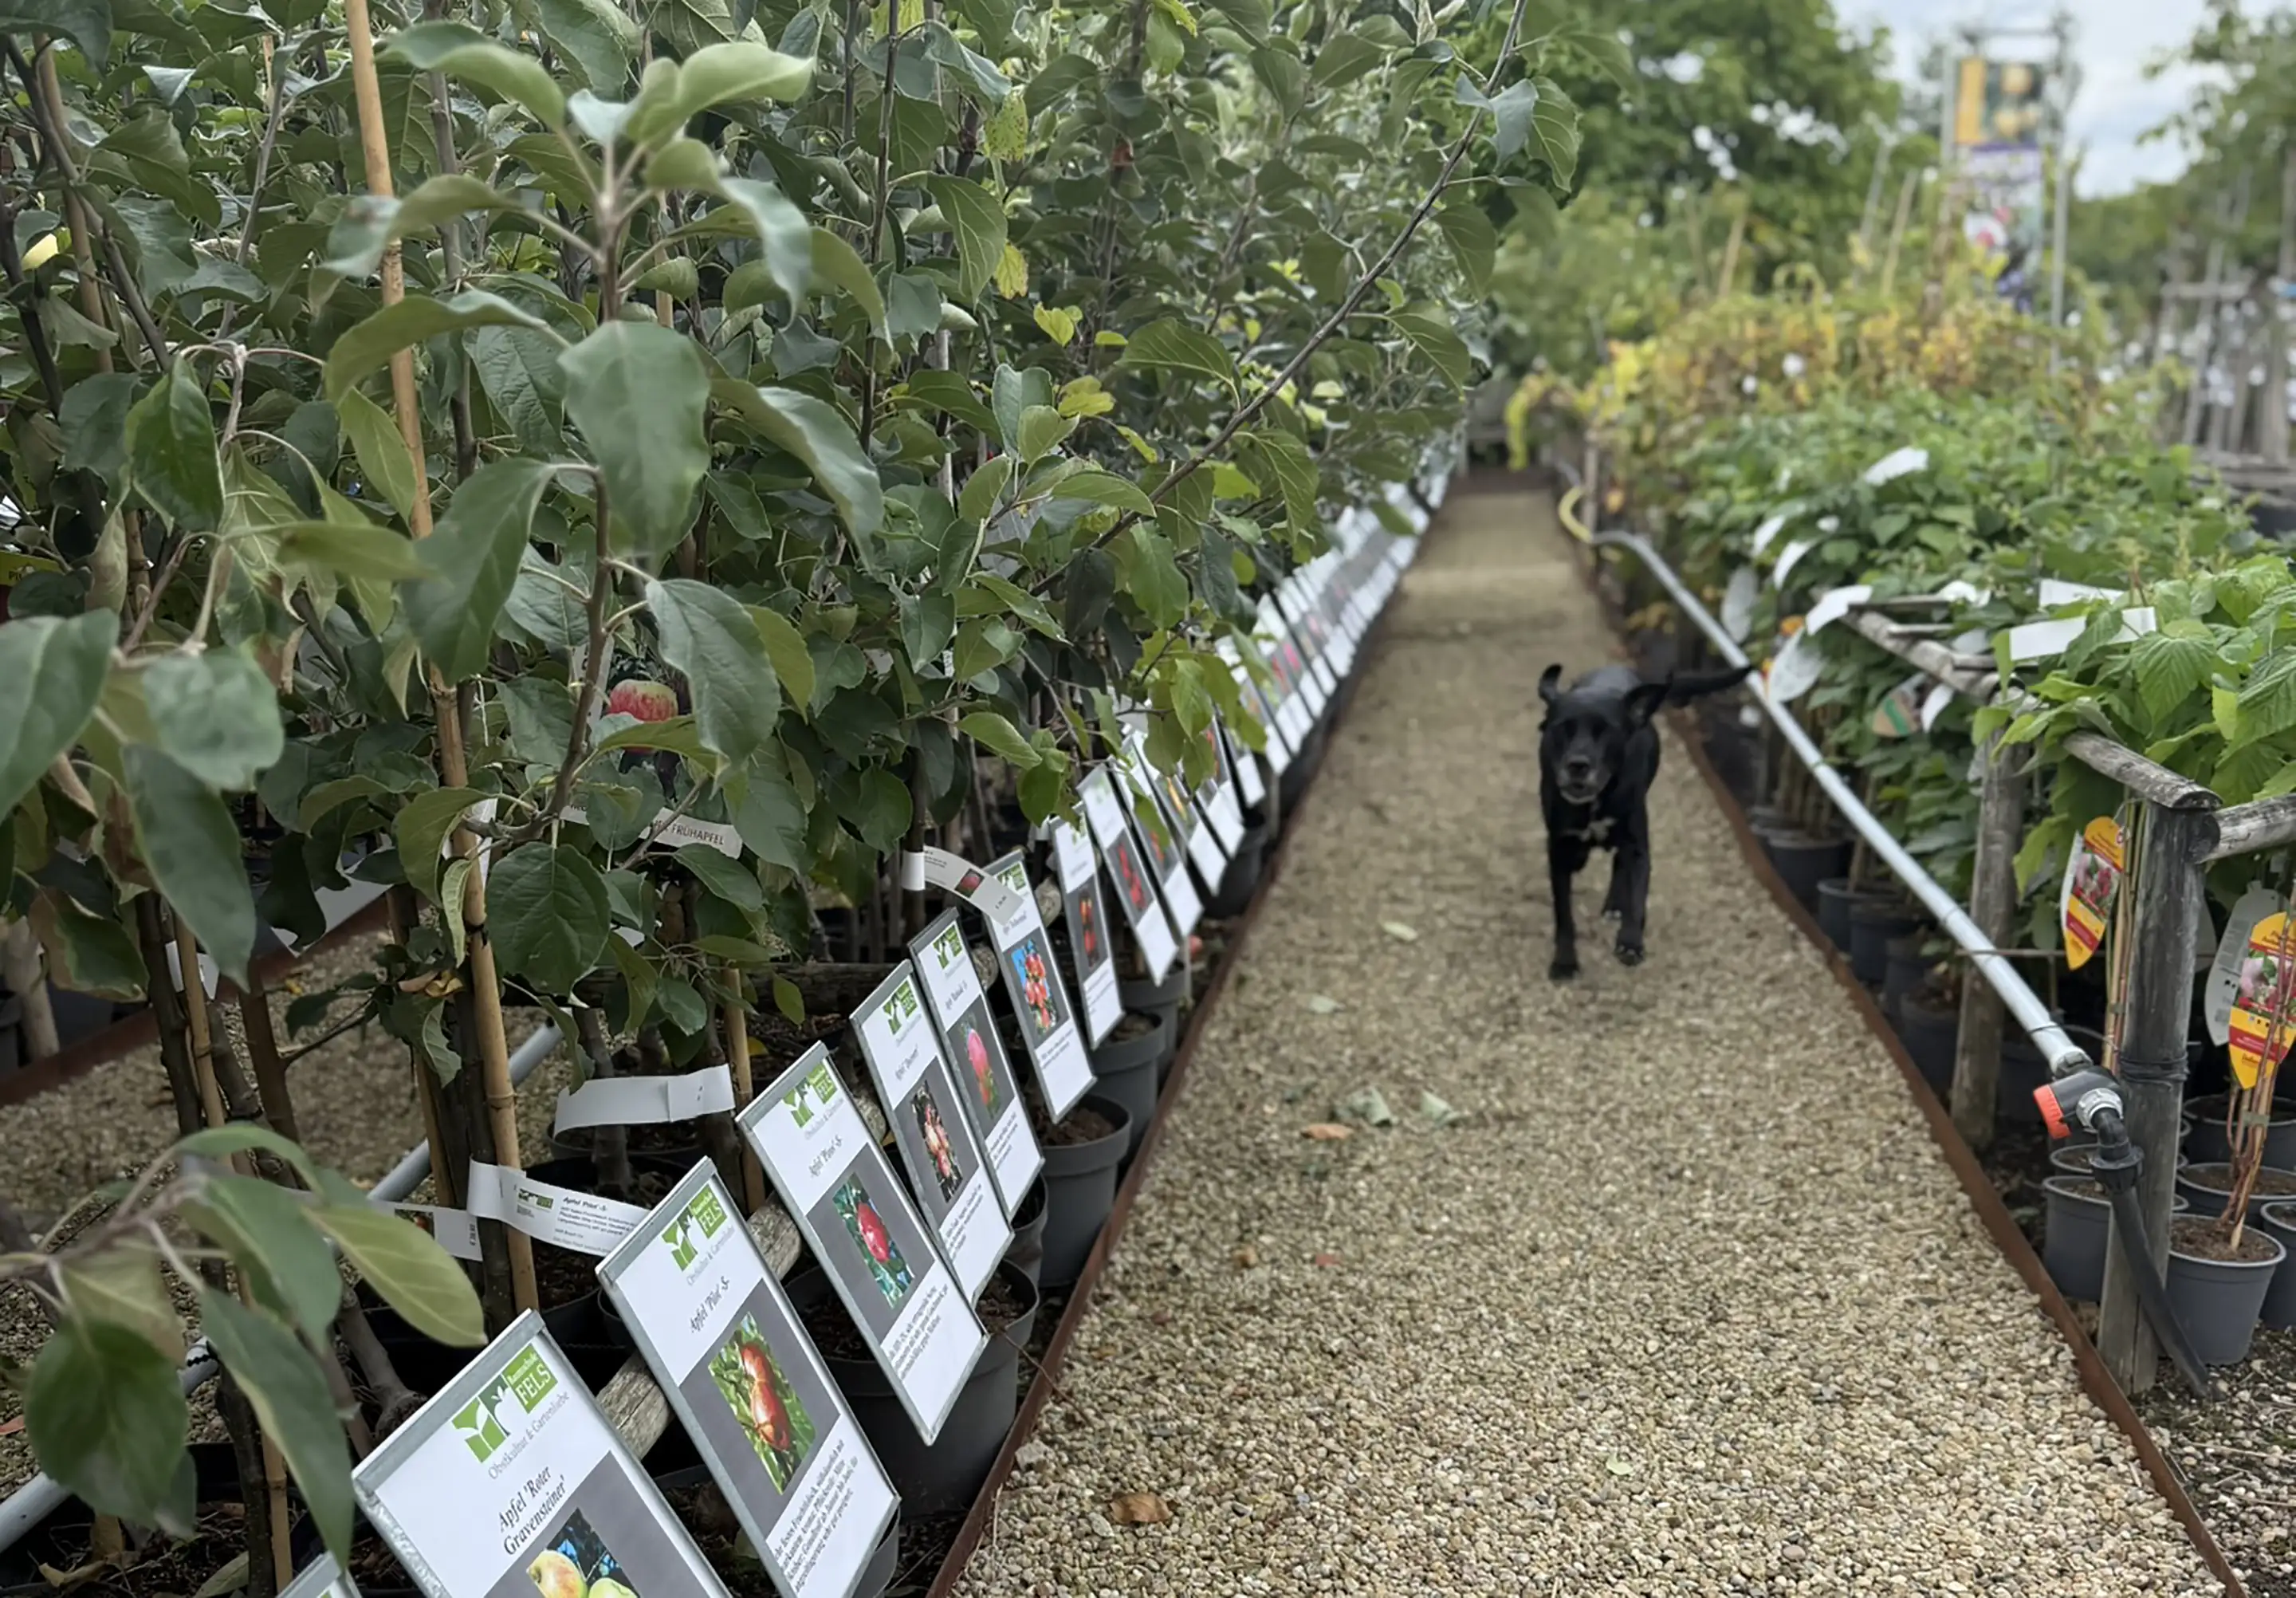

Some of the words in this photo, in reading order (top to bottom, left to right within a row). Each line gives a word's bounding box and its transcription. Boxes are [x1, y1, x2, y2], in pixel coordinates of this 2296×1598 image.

[698, 1201, 723, 1232] FELS
[515, 1363, 552, 1406] FELS
[488, 1435, 529, 1480] Obstkultur
[532, 1391, 570, 1433] Gartenliebe
[498, 1491, 527, 1533] Apfel
[523, 1466, 552, 1498] 'Roter
[503, 1474, 566, 1556] Gravensteiner'
